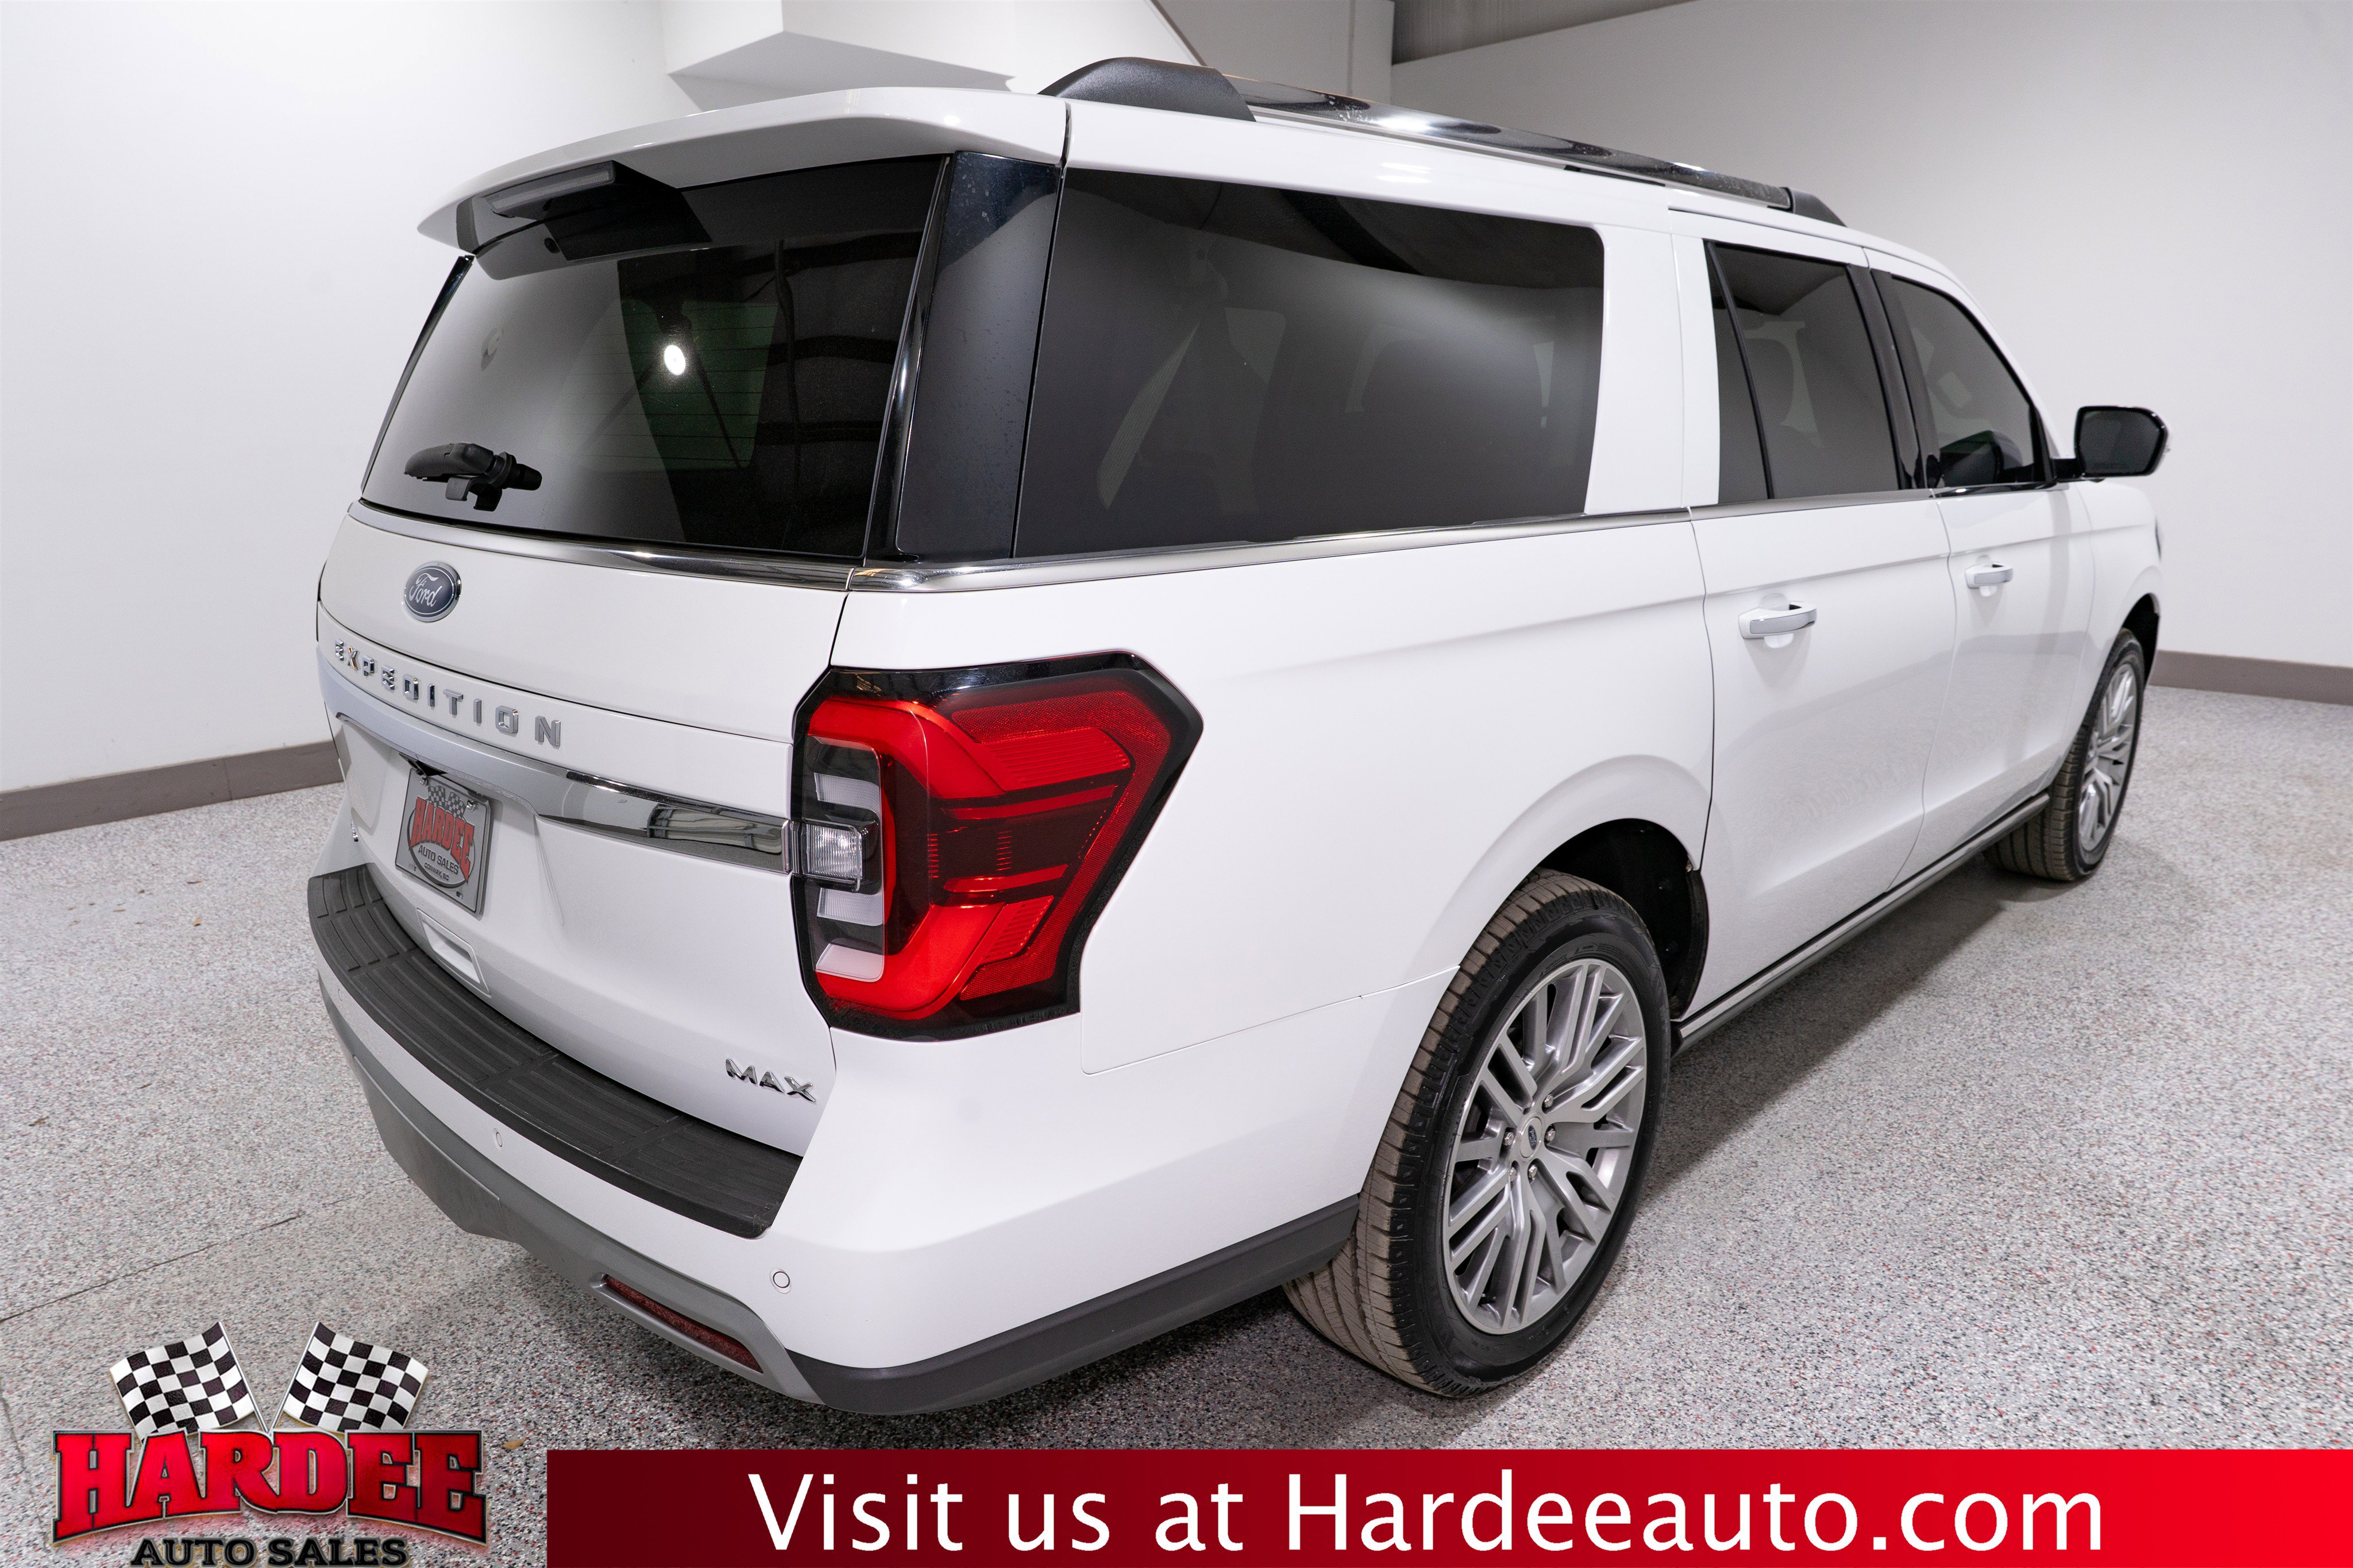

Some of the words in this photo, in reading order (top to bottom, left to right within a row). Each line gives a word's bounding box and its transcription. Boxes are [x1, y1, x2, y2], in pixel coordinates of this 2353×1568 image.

[408, 572, 443, 608] Ford
[334, 638, 562, 747] EXPEDITION
[408, 796, 475, 883] HARDEE
[418, 844, 436, 862] AUTO
[437, 855, 459, 875] SALES
[442, 872, 449, 881] SC
[725, 1058, 816, 1103] MAX
